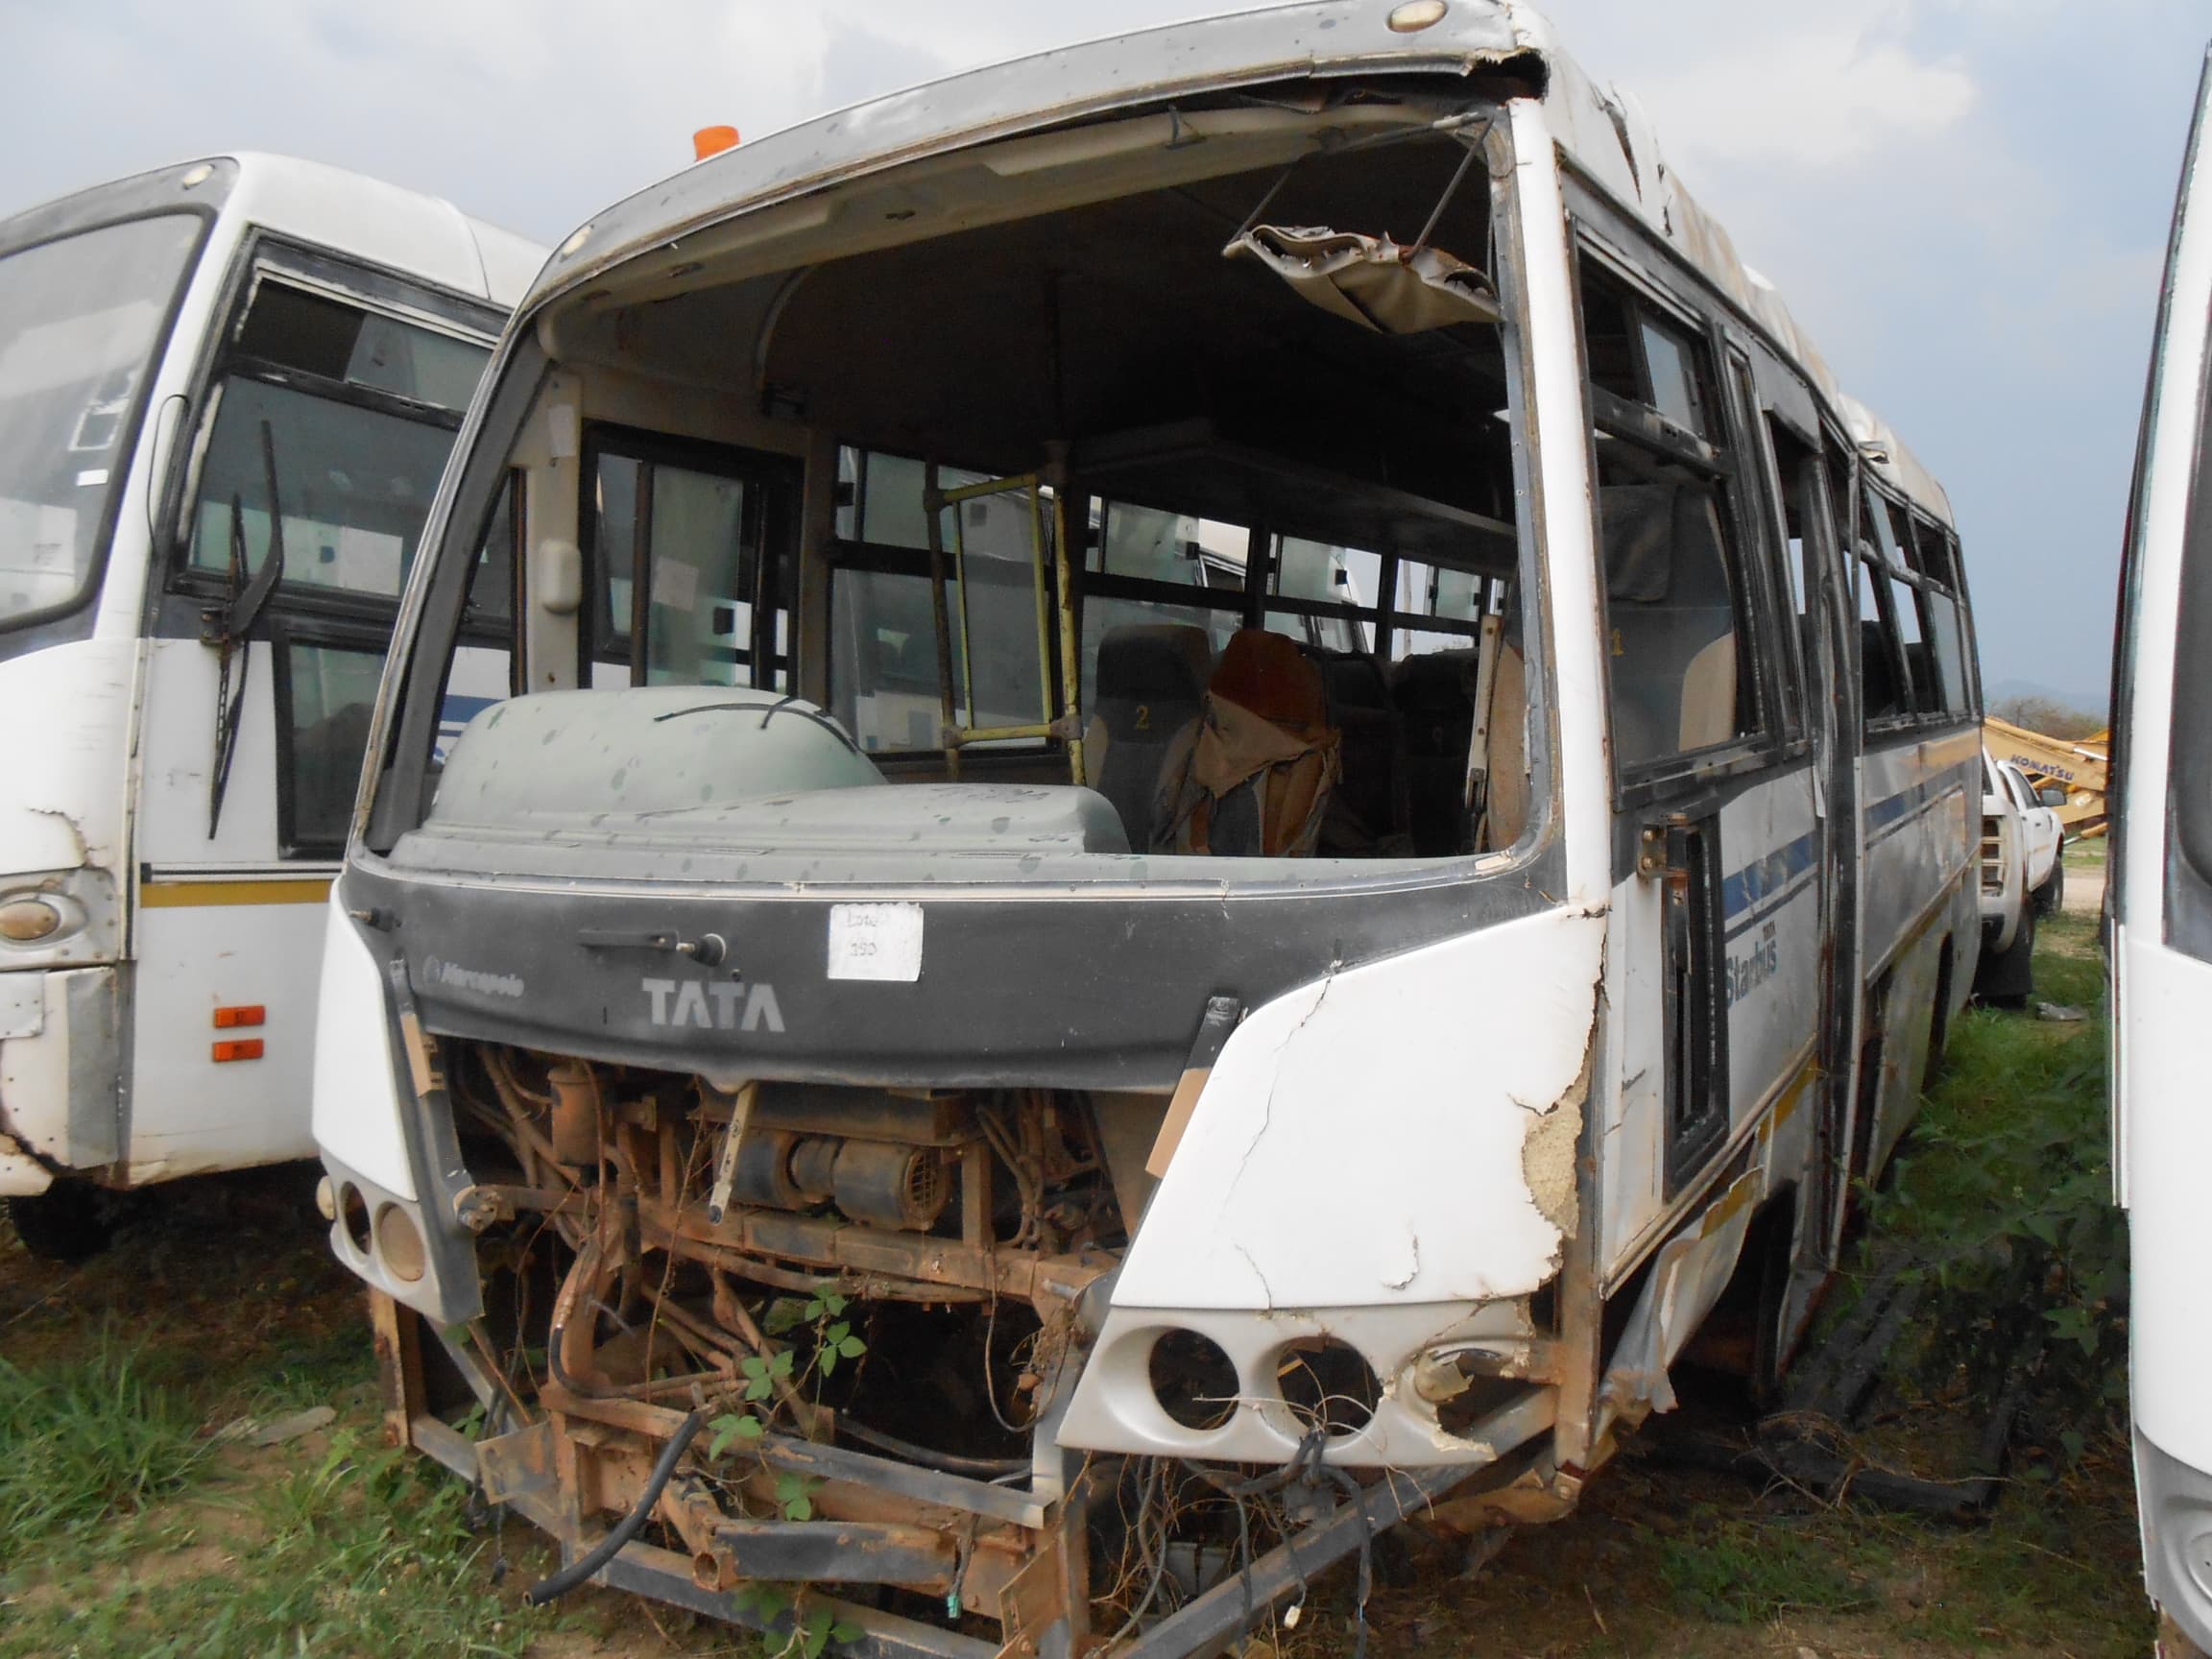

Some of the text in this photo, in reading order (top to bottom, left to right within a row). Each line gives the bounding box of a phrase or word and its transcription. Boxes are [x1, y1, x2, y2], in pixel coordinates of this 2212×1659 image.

[1136, 706, 1150, 731] 2
[2010, 755, 2074, 781] KOMATSU
[642, 978, 785, 1033] TATA
